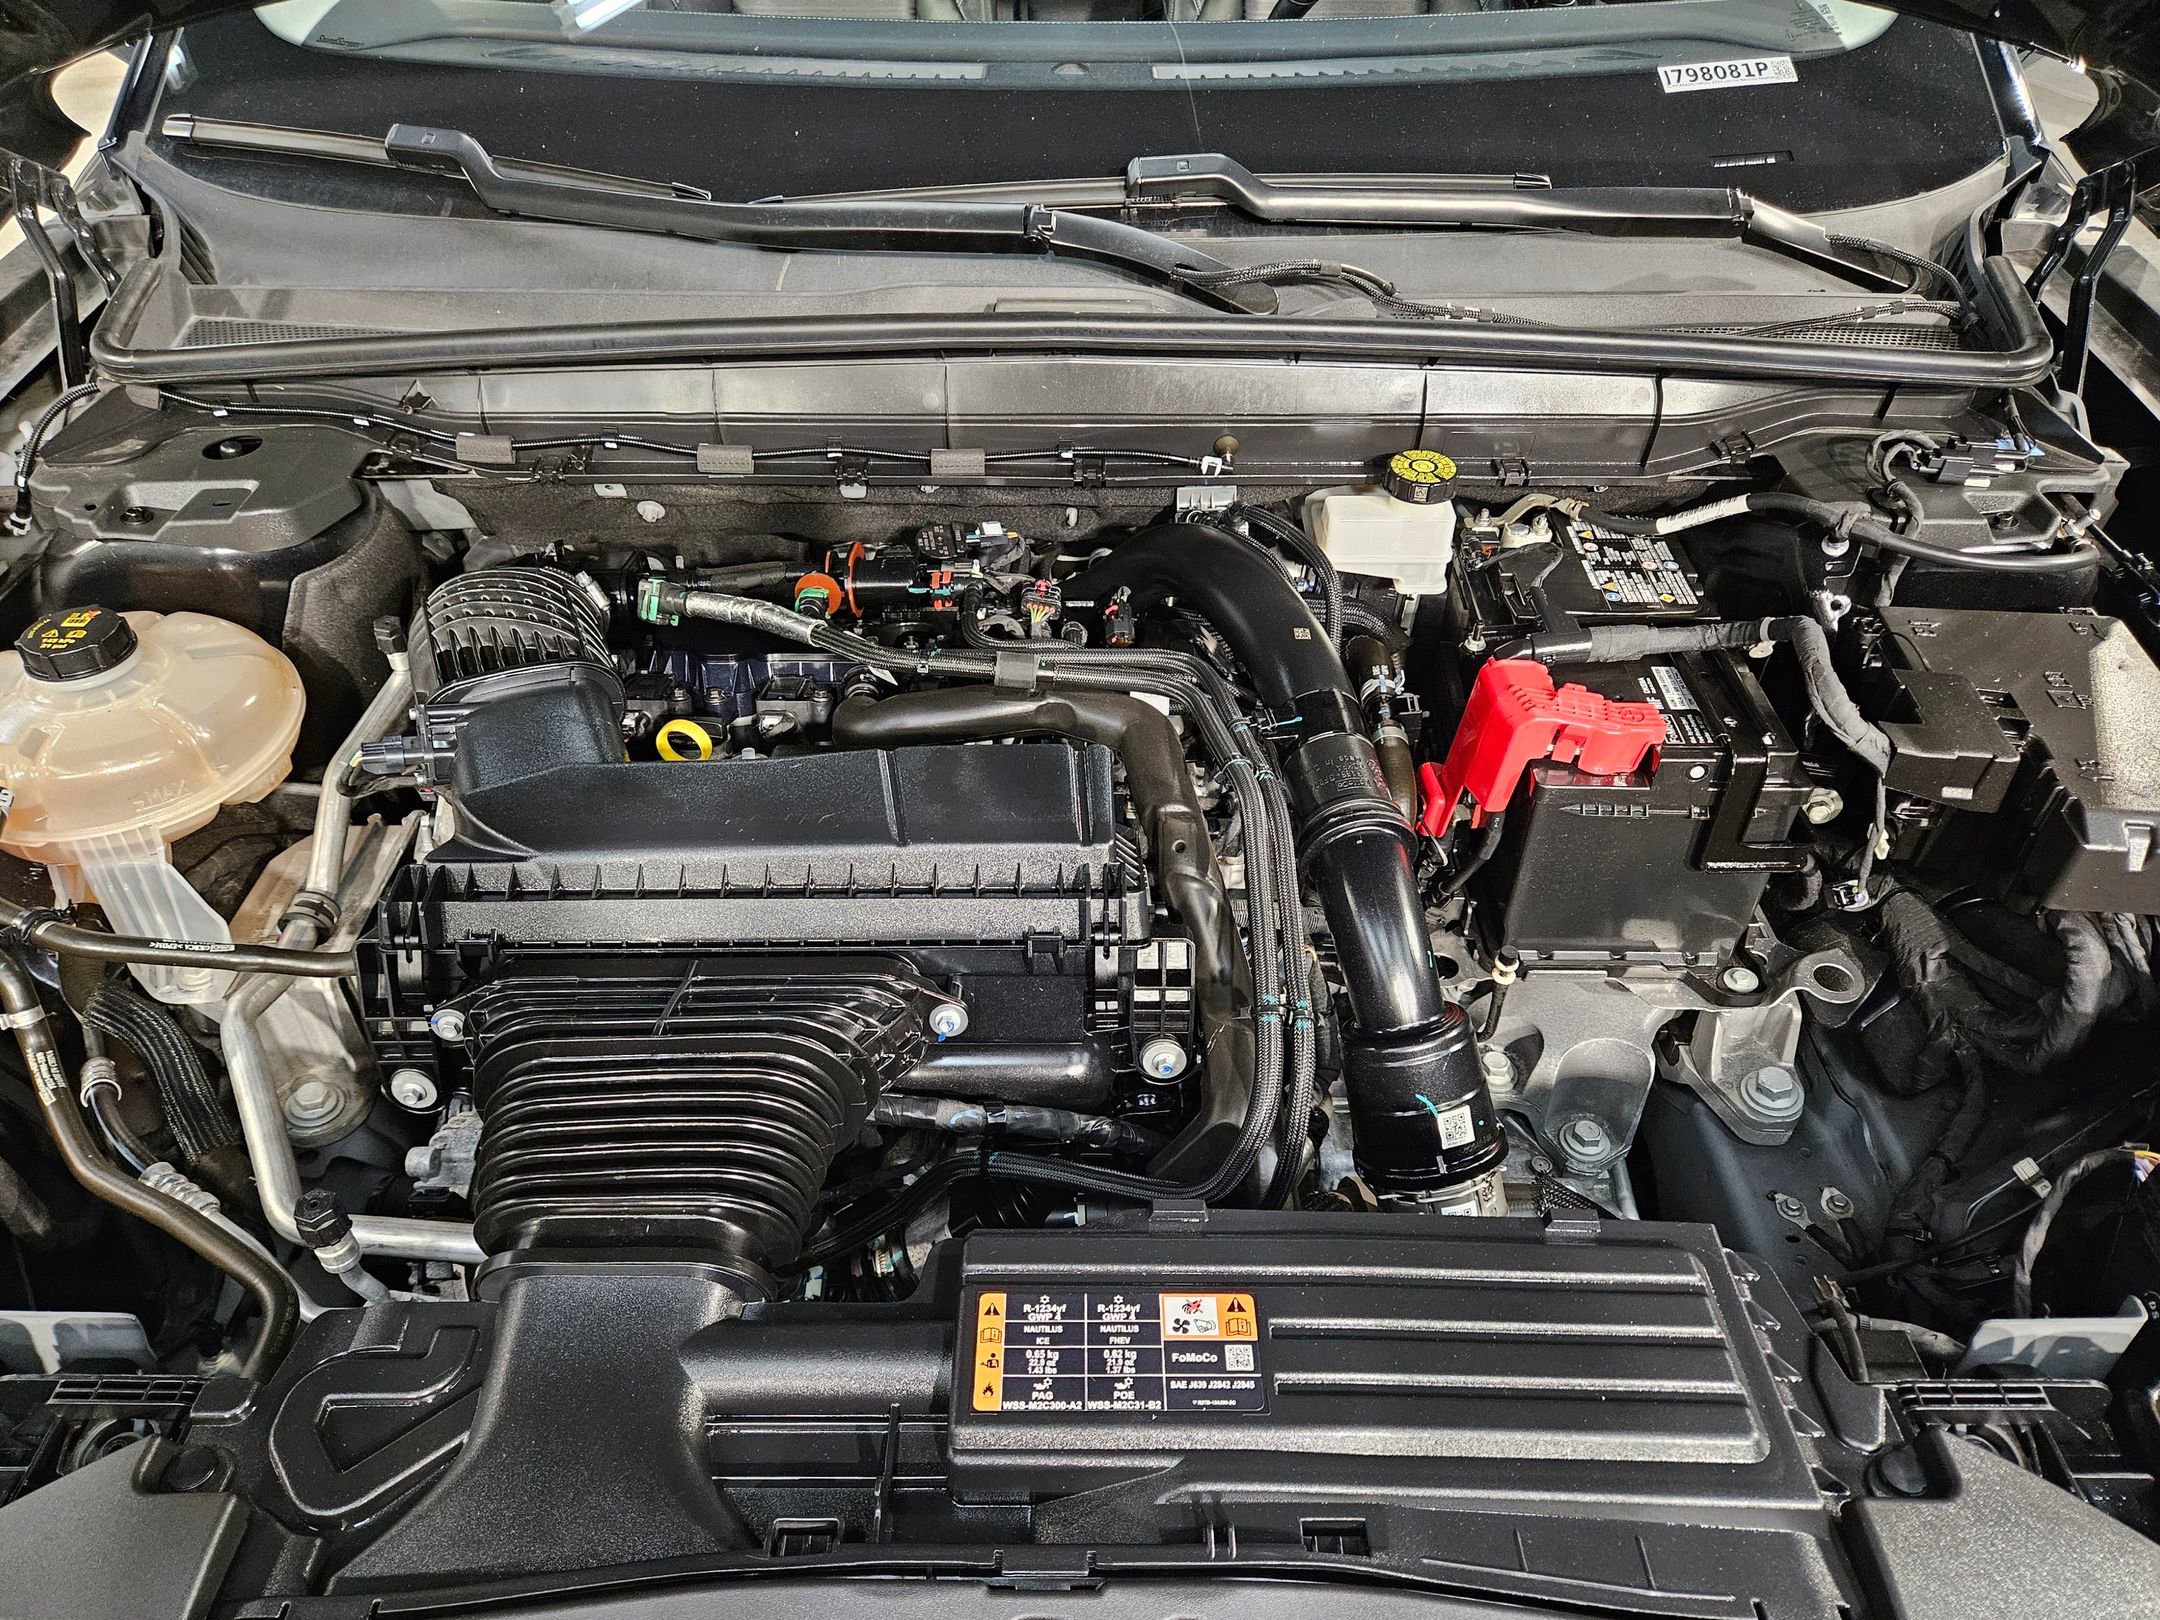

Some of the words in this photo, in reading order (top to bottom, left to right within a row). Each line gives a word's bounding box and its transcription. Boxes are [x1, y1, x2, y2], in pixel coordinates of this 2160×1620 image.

[1023, 1304, 1066, 1314] R-1234yf
[1097, 1304, 1140, 1314] R-1234yf
[1024, 1325, 1063, 1333] NAUTILUS
[1100, 1325, 1139, 1333] NAUTILUS
[1036, 1337, 1050, 1345] ICE
[1109, 1337, 1130, 1345] FHEV
[1026, 1350, 1046, 1358] 0.65
[1047, 1350, 1059, 1360] kg
[1103, 1350, 1124, 1358] 0.62
[1125, 1350, 1137, 1360] kg
[1172, 1353, 1218, 1362] FoMoCo
[1045, 1366, 1057, 1374] lbs
[1123, 1366, 1136, 1374] lbs
[1170, 1381, 1188, 1389] SAE
[1032, 1392, 1053, 1400] PAG
[1114, 1391, 1135, 1399] POE
[1003, 1401, 1082, 1410] WSS-M2C300-A2
